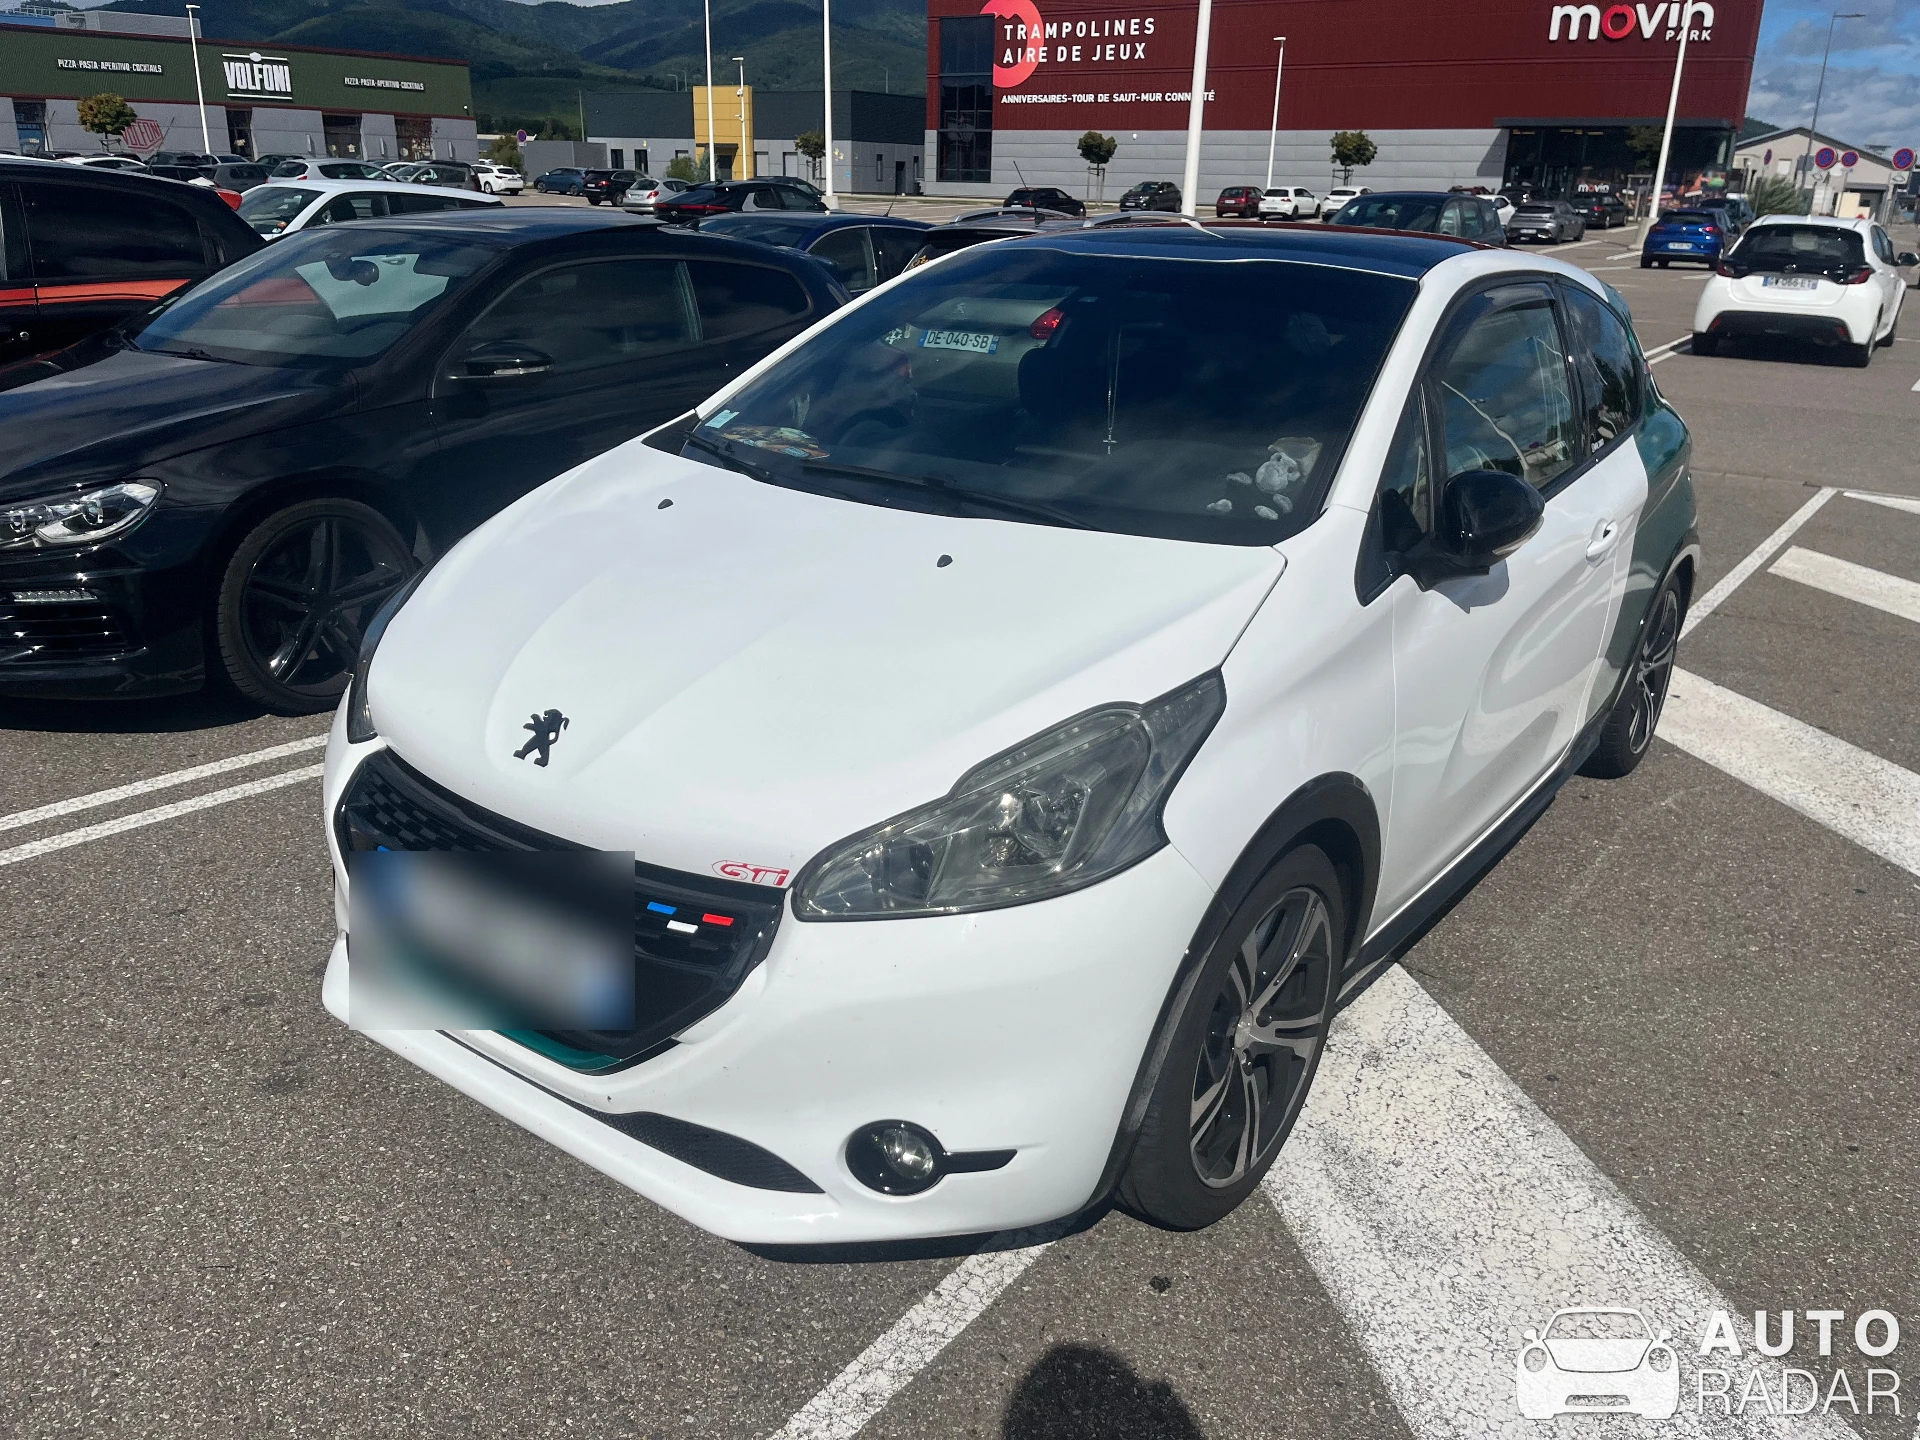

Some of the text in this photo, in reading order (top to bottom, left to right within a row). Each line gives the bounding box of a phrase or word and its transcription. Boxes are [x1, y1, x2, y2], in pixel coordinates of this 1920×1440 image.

[1003, 17, 1155, 41] TRAMPOLINES
[1549, 0, 1714, 41] movin
[1665, 30, 1712, 41] PARK
[1003, 43, 1146, 64] AIRE DE JEUX
[223, 61, 292, 93] VOLFONI
[1098, 93, 1110, 103] DE
[1164, 89, 1216, 102] CONNTÉ
[1578, 183, 1610, 193] movin
[926, 331, 989, 349] DE-040-SB
